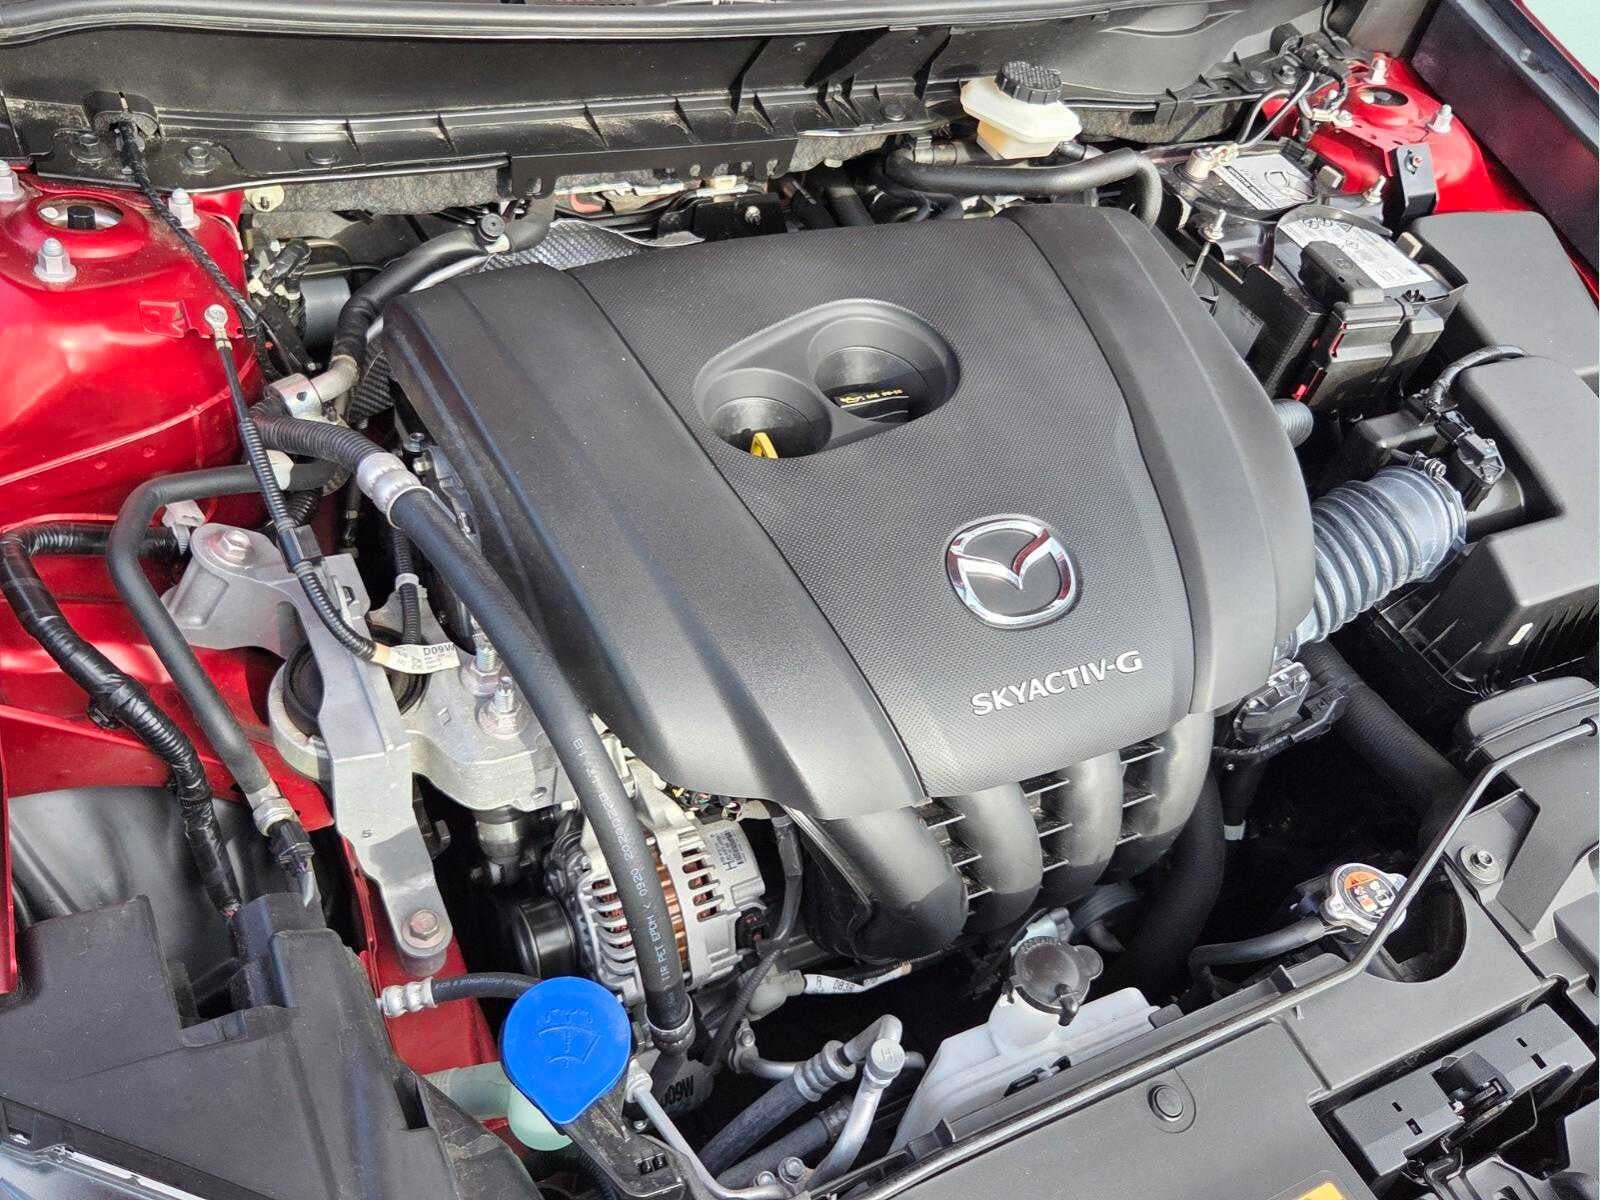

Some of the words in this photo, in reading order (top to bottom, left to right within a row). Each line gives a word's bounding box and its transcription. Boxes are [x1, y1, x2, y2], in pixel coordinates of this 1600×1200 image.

[970, 650, 1144, 716] SKYACTIV-G
[630, 868, 648, 897] 0920
[646, 914, 661, 942] EPDM
[654, 942, 666, 962] PET
